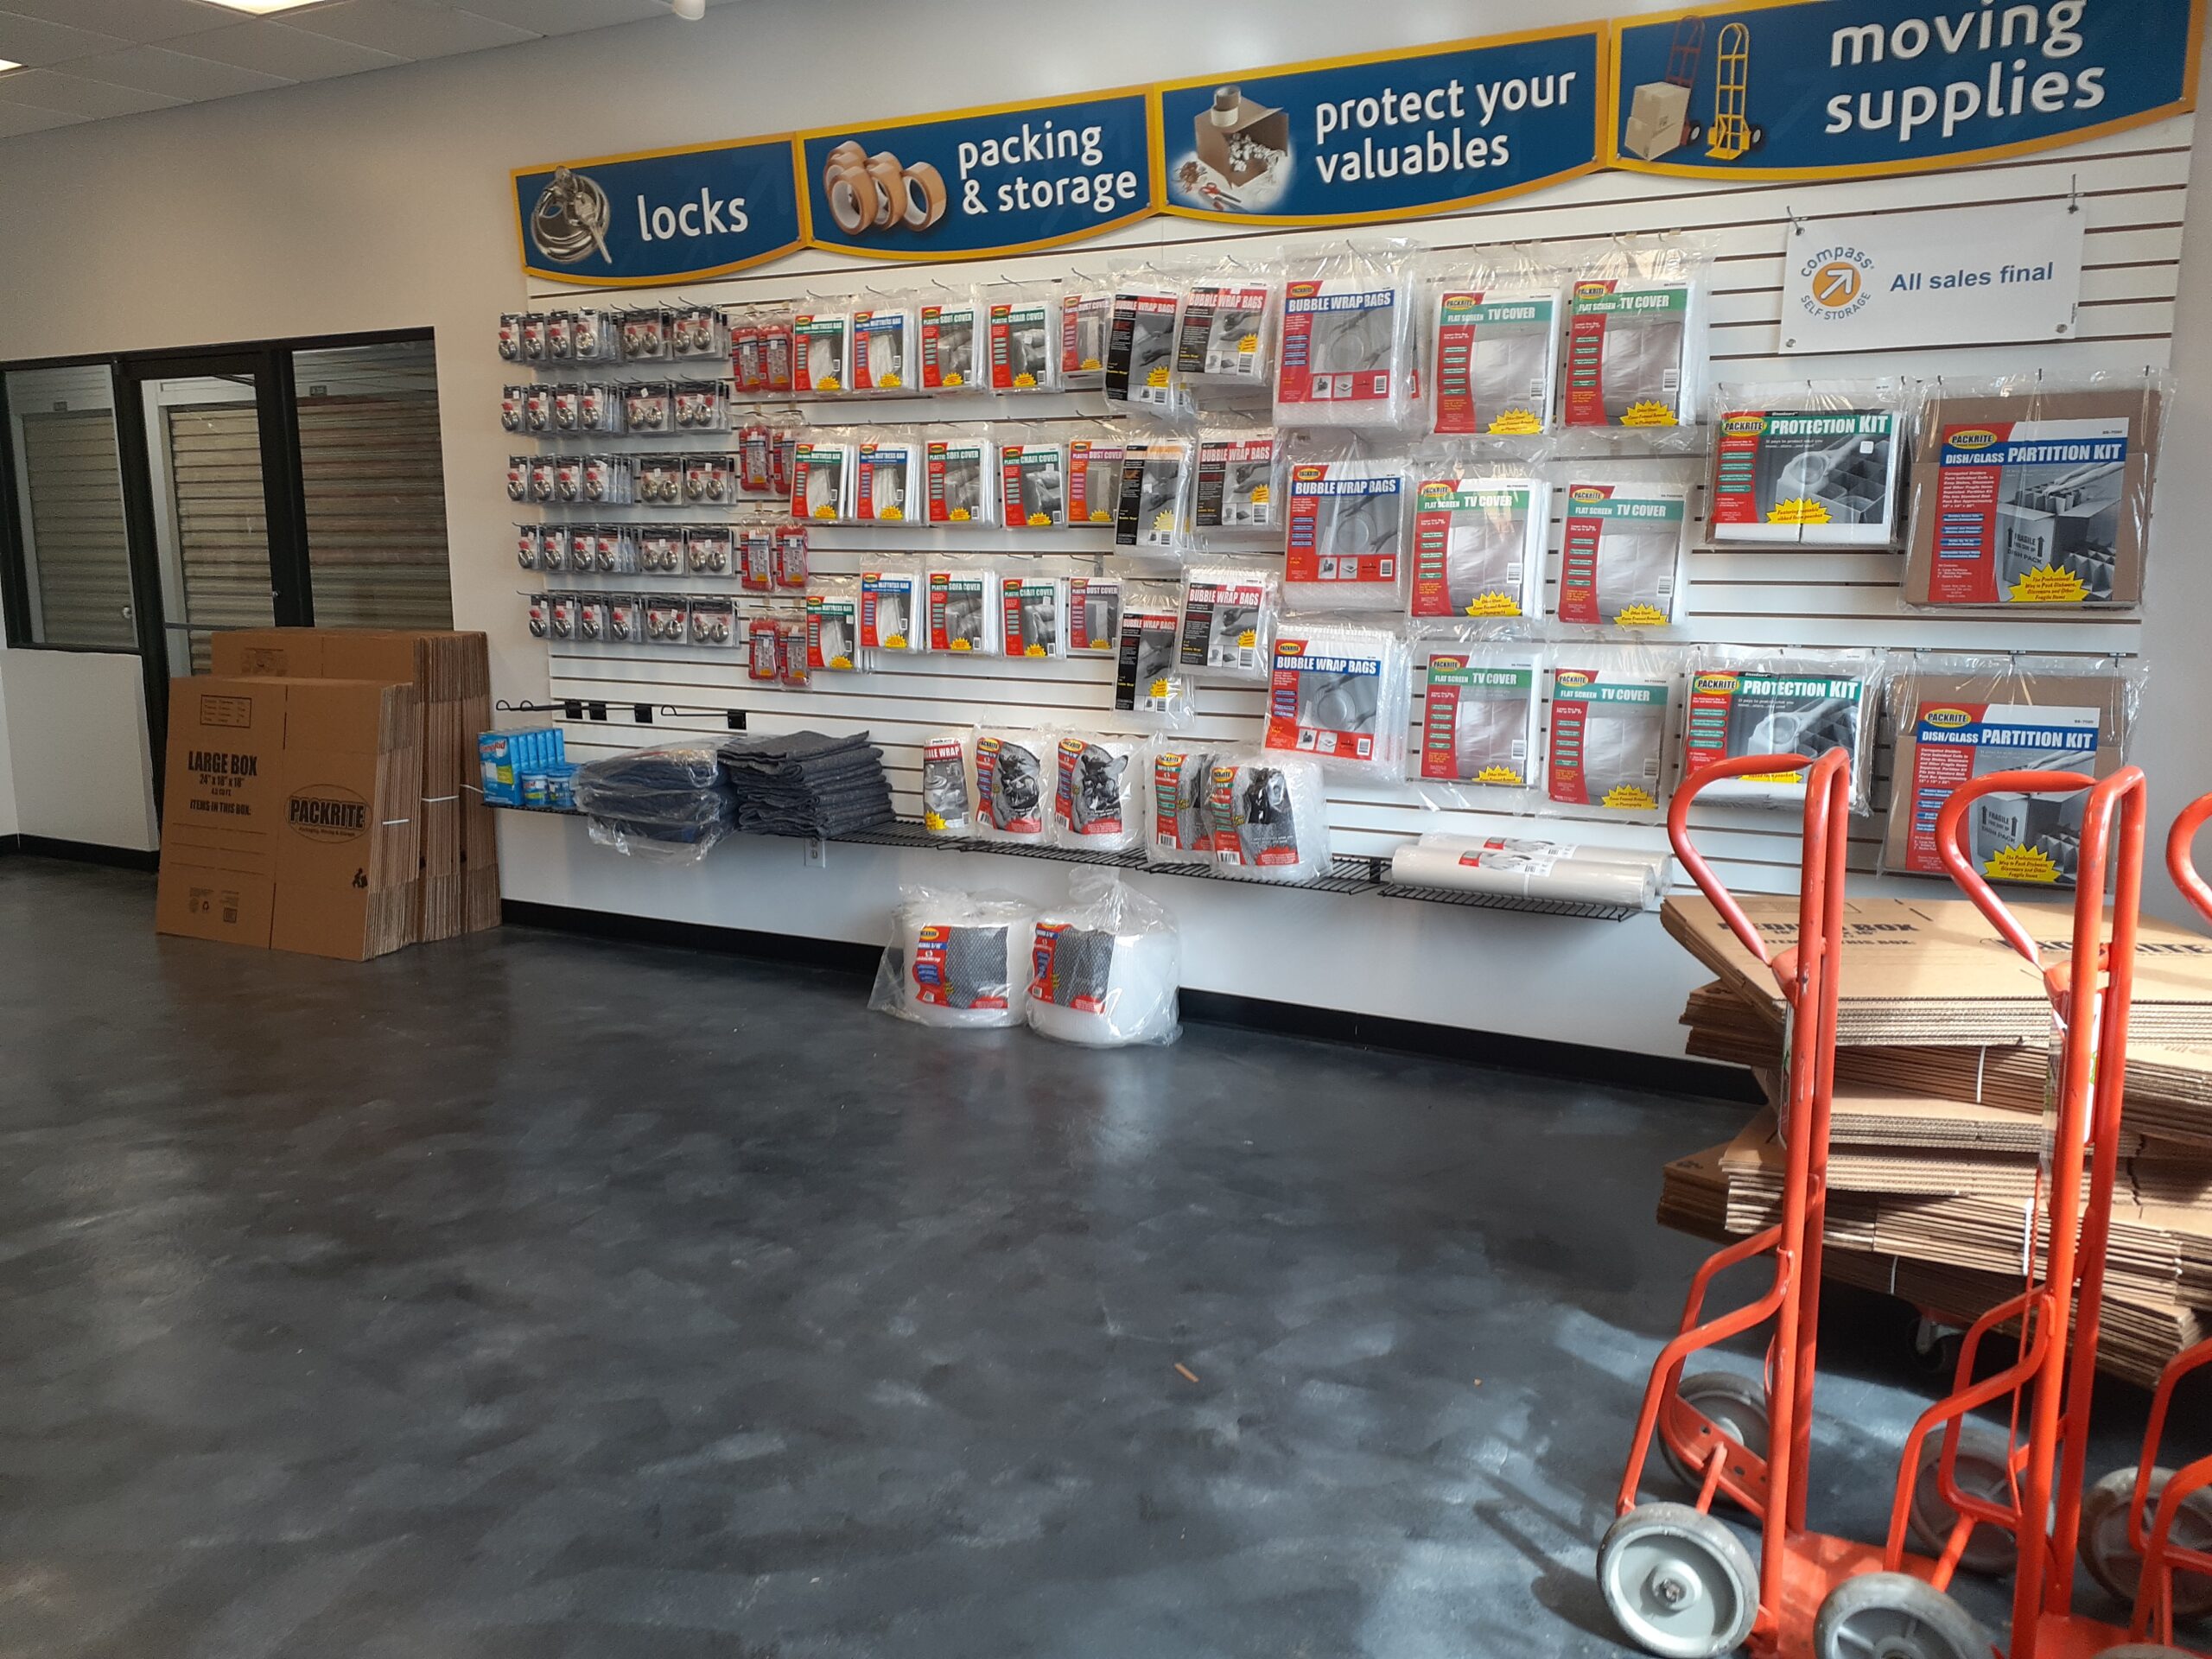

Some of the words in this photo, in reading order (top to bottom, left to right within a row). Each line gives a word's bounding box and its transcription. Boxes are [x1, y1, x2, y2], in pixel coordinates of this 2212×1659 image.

[1829, 0, 2087, 58] moving
[1825, 58, 2106, 142] supplies
[1315, 79, 1465, 145] protect
[1476, 72, 1576, 127] your
[957, 120, 1103, 178] packing
[1315, 127, 1510, 183] valuables
[962, 185, 988, 215] &
[997, 169, 1138, 213] storage
[636, 188, 749, 243] locks
[1801, 245, 1872, 278] compass
[1890, 272, 1922, 292] All
[1929, 270, 1992, 289] sales
[1999, 262, 2054, 283] final
[1115, 299, 1137, 311] BUBBLE
[1138, 302, 1156, 313] WRAP
[1157, 303, 1175, 314] BAGS
[1190, 292, 1218, 308] BUBBLE
[1218, 294, 1241, 308] WRAP
[1242, 296, 1263, 308] BAGS
[1288, 297, 1330, 313] BUBBLE
[1331, 295, 1363, 309] WRAP
[1363, 292, 1391, 308] BAGS
[1579, 303, 1592, 312] FLAT
[1593, 302, 1617, 311] SCREEN
[1620, 296, 1634, 309] TV
[1635, 295, 1669, 308] COVER
[1801, 295, 1823, 318] SELF
[1823, 291, 1872, 321] STORAGE
[954, 313, 973, 322] COVER
[1026, 312, 1045, 321] COVER
[1488, 308, 1502, 321] TV
[1502, 307, 1535, 320] COVER
[1725, 421, 1764, 431] PACKRITE
[1770, 418, 1856, 435] PROTECTION
[1859, 415, 1889, 433] KIT
[1951, 434, 1993, 443] PACKRITE
[960, 449, 979, 460] COVER
[1039, 454, 1058, 463] COVER
[1089, 450, 1103, 460] DUST
[1103, 450, 1122, 460] COVER
[1201, 449, 1228, 461] BUBBLE
[1229, 448, 1250, 461] WRAP
[1251, 446, 1270, 460] BAGS
[1945, 452, 2005, 465] DISH/GLASS
[2007, 444, 2090, 463] PARTITION
[2094, 443, 2122, 460] KIT
[1295, 481, 1336, 495] BUBBLE
[1336, 480, 1368, 494] WRAP
[1369, 479, 1396, 493] BAGS
[1424, 501, 1437, 510] FLAT
[1464, 496, 1478, 507] TV
[1478, 495, 1513, 507] COVER
[1574, 492, 1602, 500] PACKRITE
[1575, 506, 1589, 515] FLAT
[1589, 506, 1613, 515] SCREEN
[1617, 504, 1631, 516] TV
[1631, 504, 1667, 517] COVER
[948, 582, 963, 591] SOFA
[963, 582, 982, 591] COVER
[1036, 588, 1053, 597] COVER
[1086, 587, 1101, 595] DUST
[1101, 586, 1118, 595] COVER
[1189, 589, 1216, 603] BUBBLE
[1217, 590, 1238, 604] WRAP
[1239, 592, 1260, 605] BAGS
[1122, 619, 1143, 629] BUBBLE
[1143, 620, 1160, 630] WRAP
[1160, 620, 1176, 631] BAGS
[1276, 656, 1315, 671] BUBBLE
[1315, 658, 1347, 672] WRAP
[1348, 659, 1376, 674] BAGS
[1472, 672, 1485, 683] TV
[1486, 673, 1517, 685] COVER
[1559, 675, 1587, 684] PACKRITE
[1574, 690, 1597, 699] SCREEN
[1601, 688, 1615, 699] TV
[1616, 688, 1650, 702] COVER
[1697, 679, 1736, 690] PACKRITE
[1743, 679, 1827, 697] PROTECTION
[1828, 681, 1859, 699] KIT
[1928, 713, 1967, 723] PACKRITE
[1922, 731, 1979, 744] DISH/GLASS
[1981, 728, 2063, 747] PARTITION
[2065, 732, 2094, 749] KIT
[939, 745, 961, 757] WRAP
[188, 750, 228, 774] LARGE
[231, 754, 258, 777] BOX
[199, 773, 212, 785] 24"
[189, 798, 210, 811] ITEMS
[210, 800, 218, 811] IN
[219, 801, 235, 814] THIS
[235, 803, 251, 816] BOX:
[289, 798, 366, 830] PACKRITE
[1851, 923, 1922, 932] BOX
